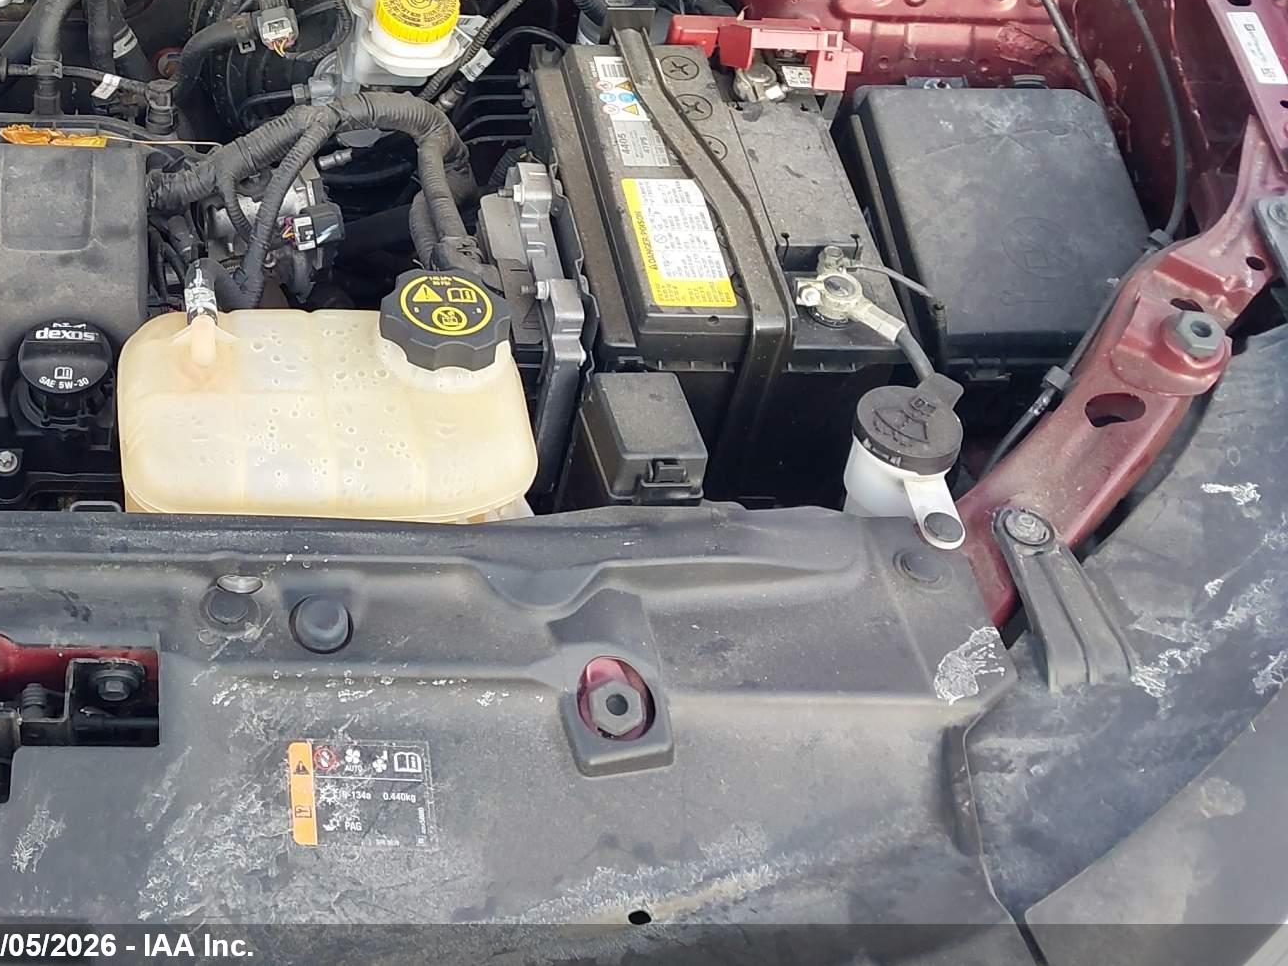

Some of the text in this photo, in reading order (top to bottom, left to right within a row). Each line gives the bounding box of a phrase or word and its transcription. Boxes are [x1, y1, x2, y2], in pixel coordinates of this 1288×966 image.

[35, 327, 96, 341] dexos
[39, 376, 90, 390] SAE 5W-30
[344, 764, 363, 773] AUTO
[382, 791, 417, 803] 0.440kg
[344, 821, 362, 832] PAG
